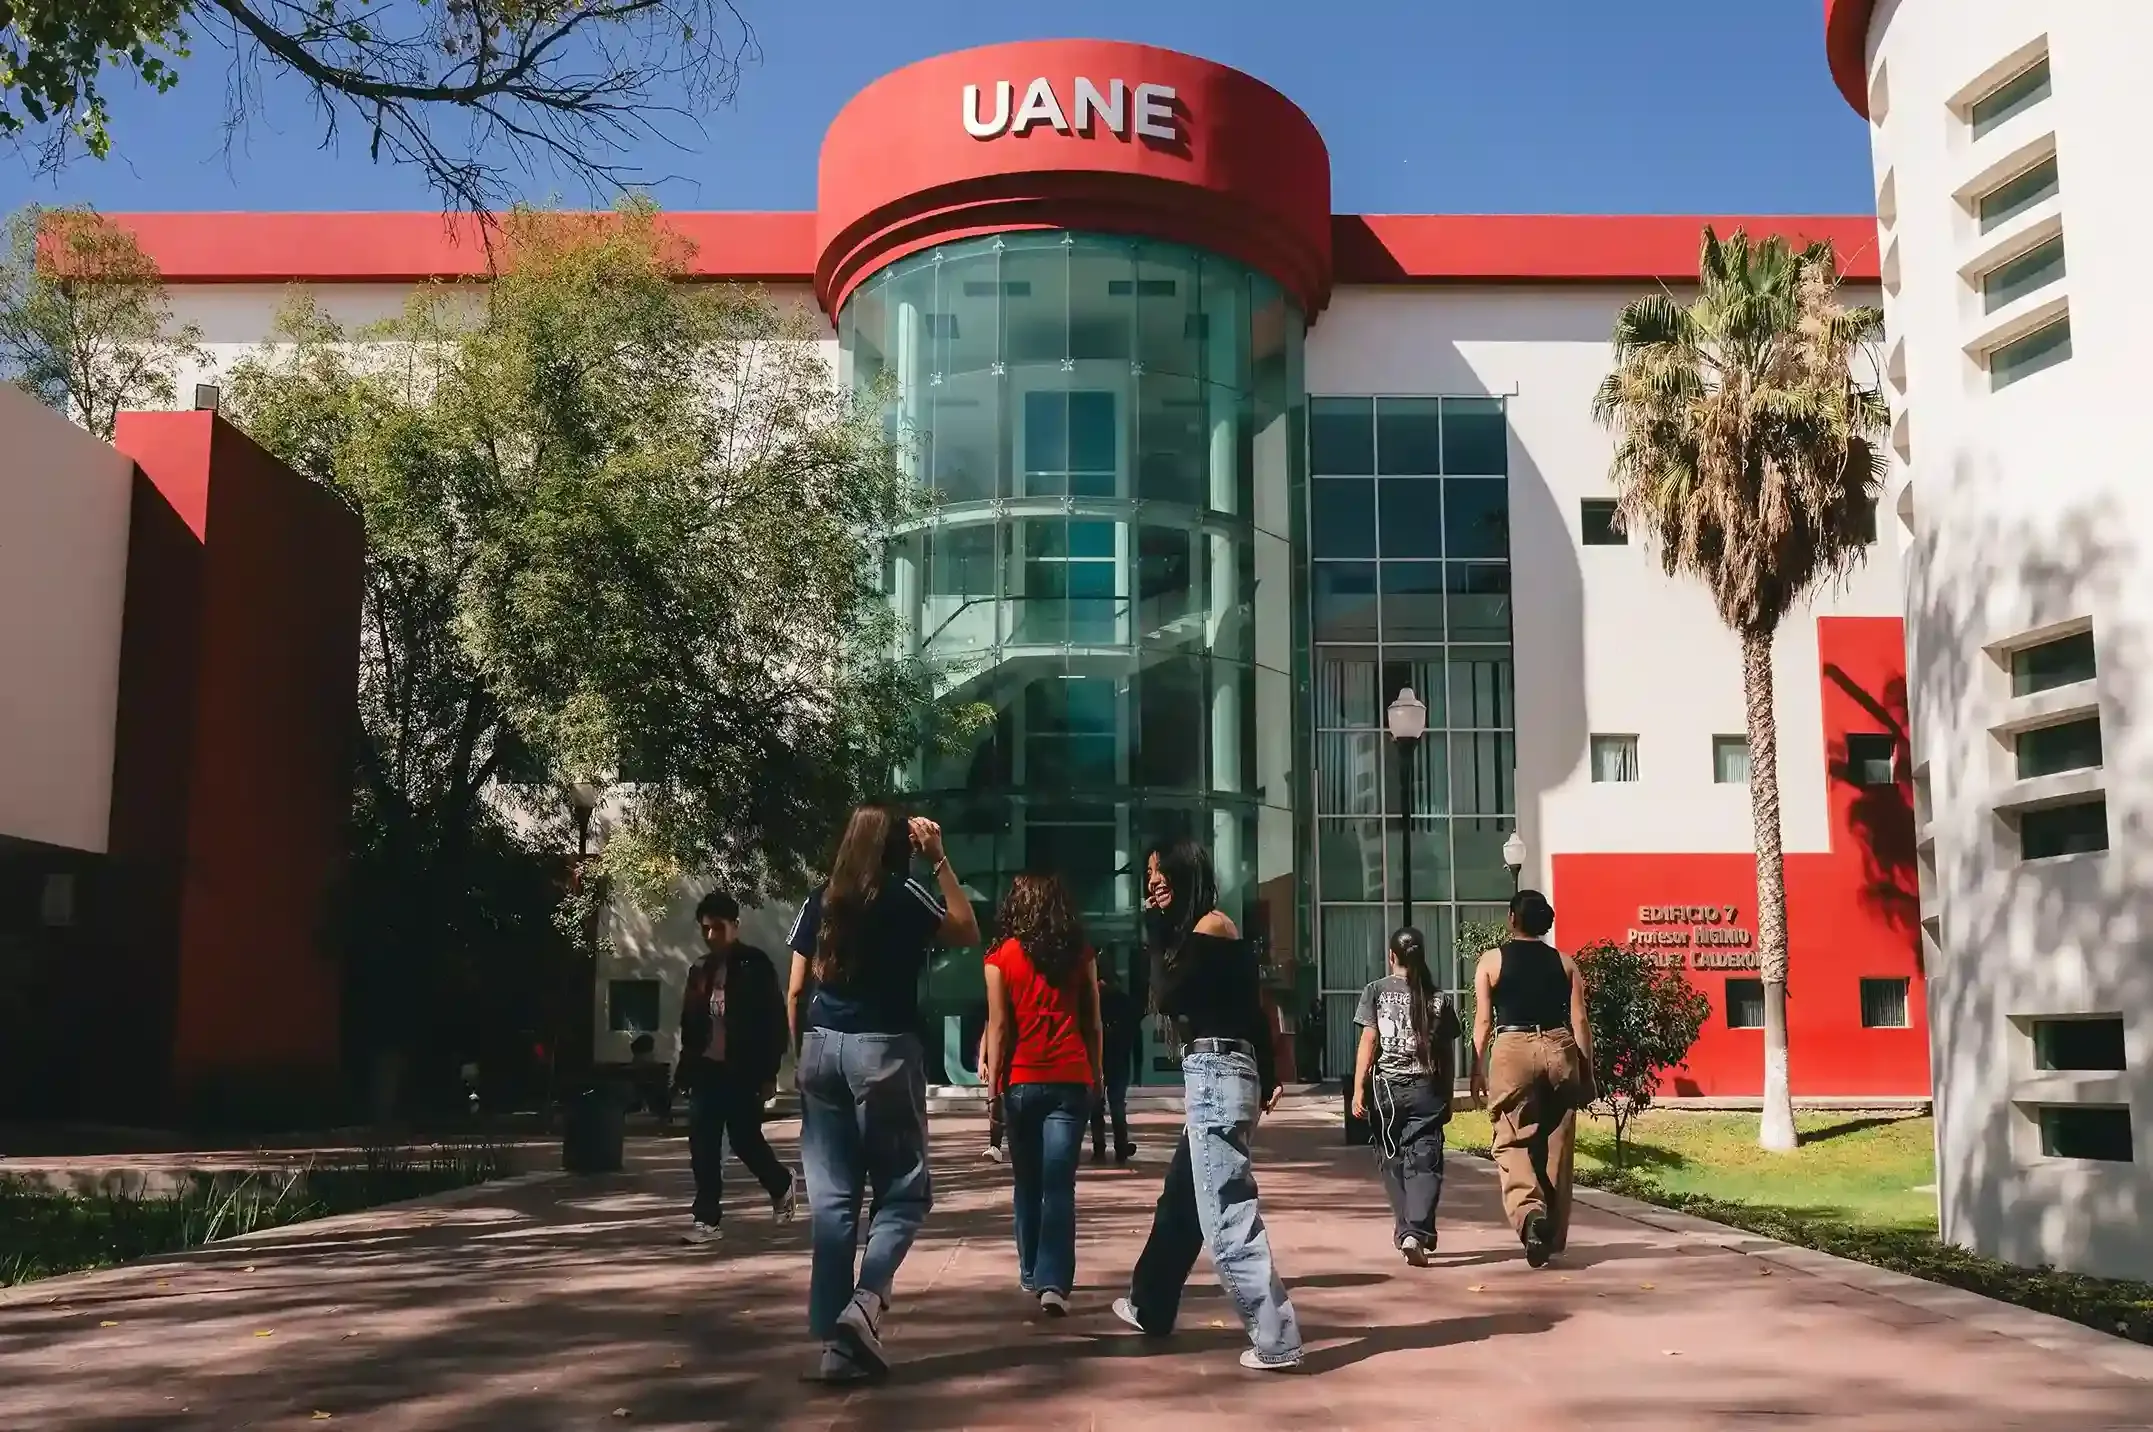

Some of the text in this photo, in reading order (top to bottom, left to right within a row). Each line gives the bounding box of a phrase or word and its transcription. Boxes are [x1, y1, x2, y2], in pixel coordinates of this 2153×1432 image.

[963, 76, 1176, 141] UANE
[1638, 905, 1737, 922] EDIFICIO 7
[1627, 926, 1750, 944] Profesor HIGINIO
